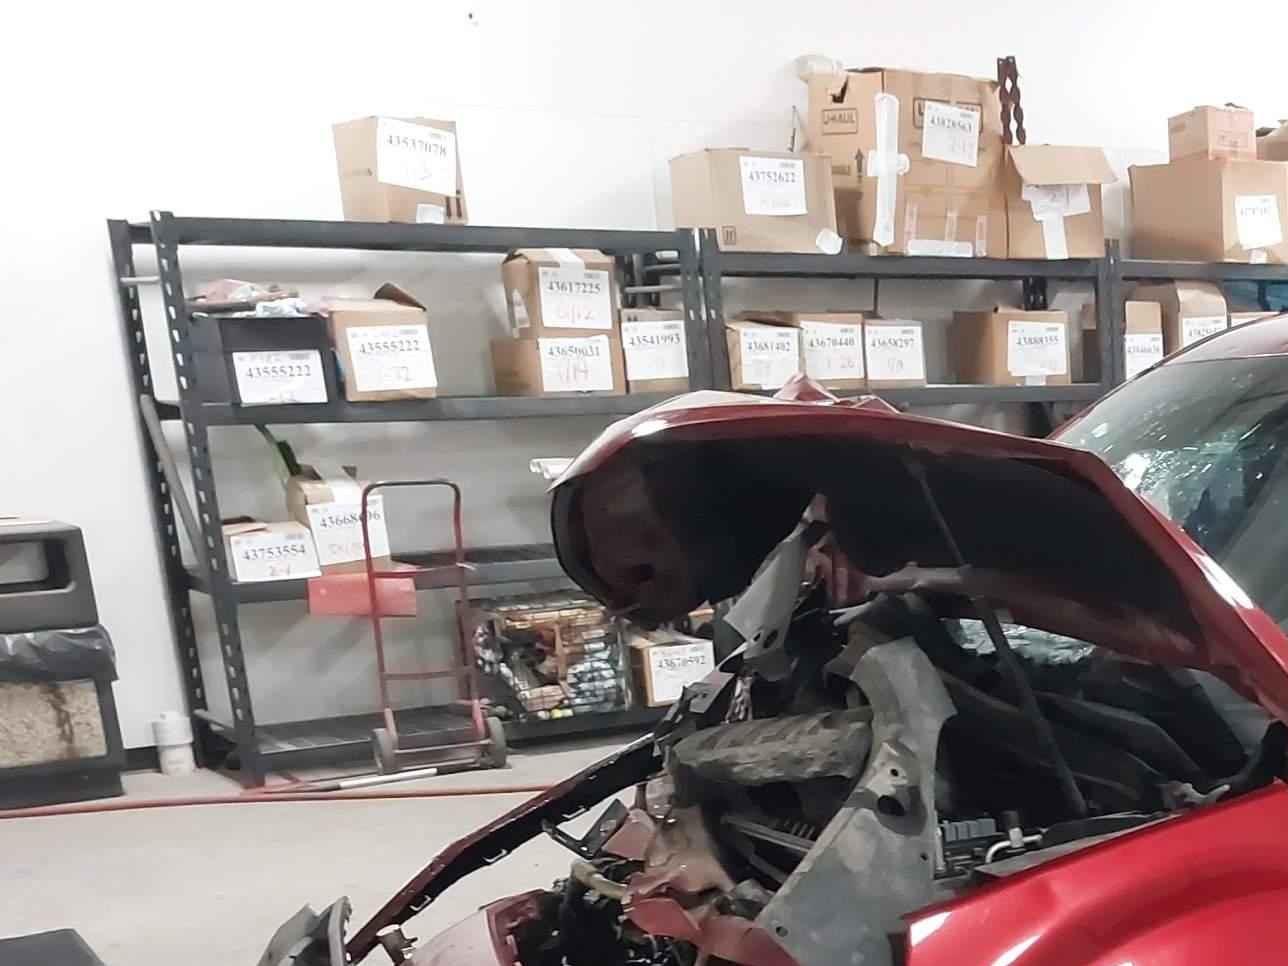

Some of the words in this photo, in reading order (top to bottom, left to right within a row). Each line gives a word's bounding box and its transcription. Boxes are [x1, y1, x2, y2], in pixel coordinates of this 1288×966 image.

[749, 170, 796, 183] 43752622
[548, 280, 601, 294] 43617225
[360, 339, 421, 355] 43555222
[629, 332, 681, 347] 43541993
[809, 337, 855, 348] 43670440
[246, 364, 313, 379] 43555222
[242, 544, 306, 561] 43753554
